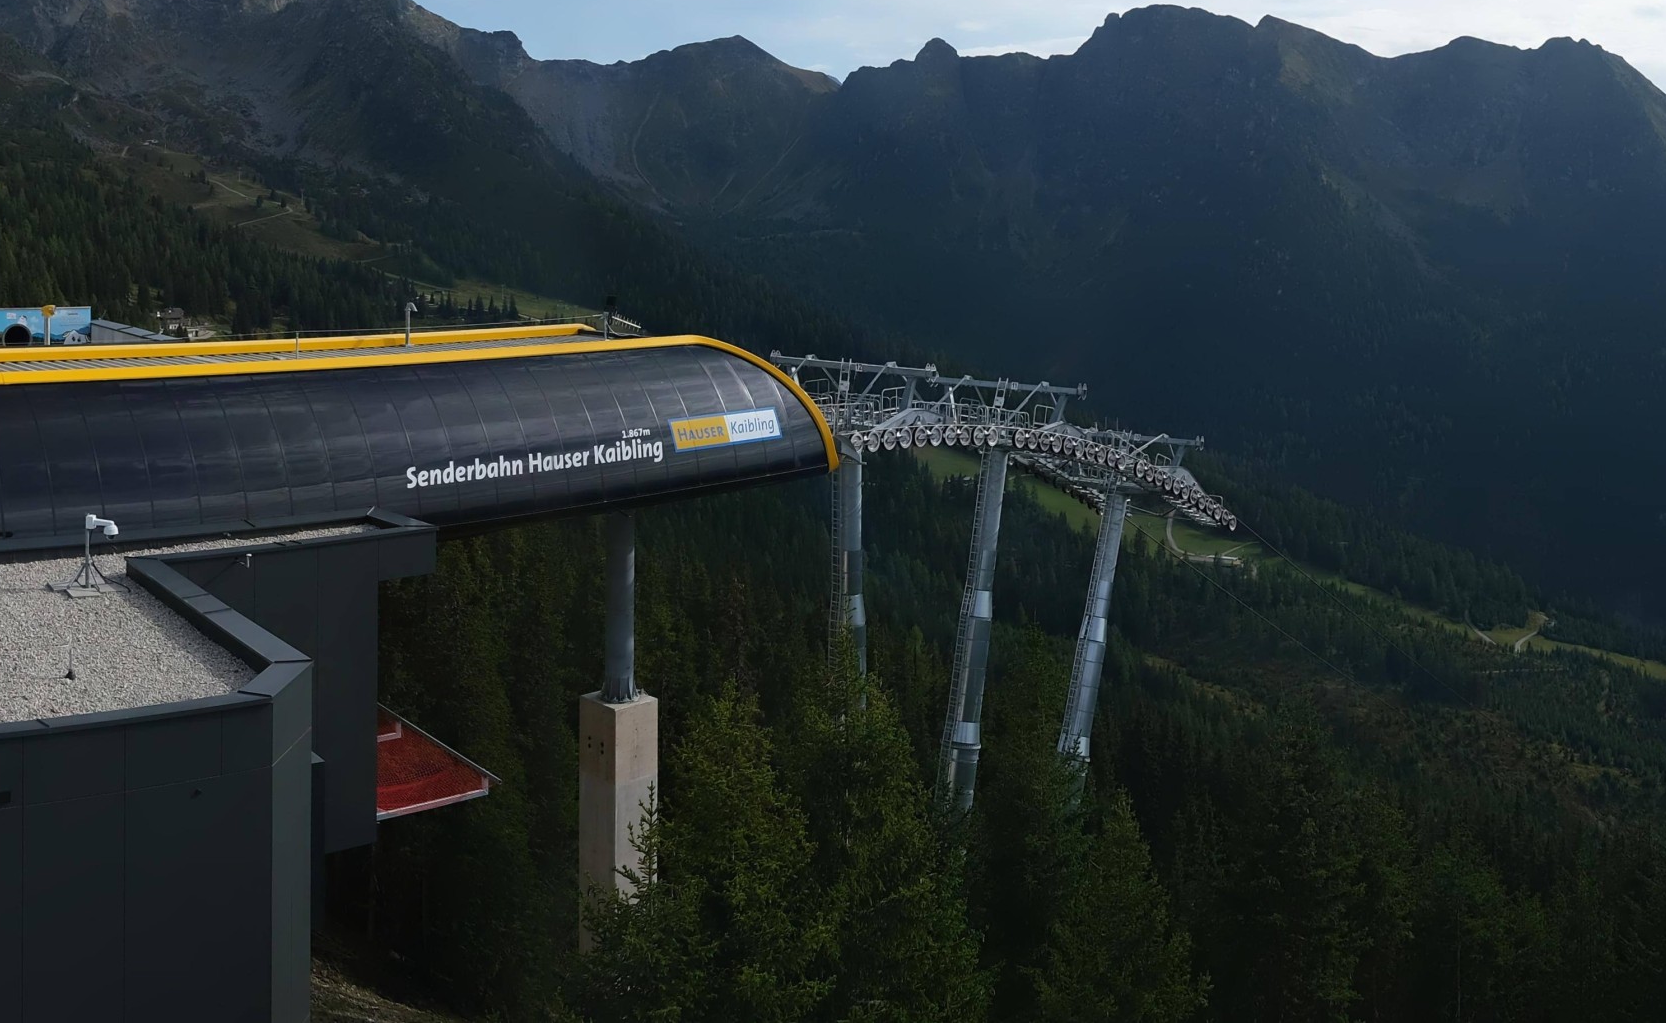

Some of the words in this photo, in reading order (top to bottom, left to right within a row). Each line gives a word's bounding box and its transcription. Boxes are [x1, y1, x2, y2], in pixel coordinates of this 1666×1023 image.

[621, 427, 651, 439] 1.867m
[677, 425, 724, 442] HAUSER
[730, 416, 775, 435] Kaibling
[406, 455, 523, 489] Senderbahn
[528, 447, 590, 474] Hauser
[593, 438, 663, 465] Kaibling
